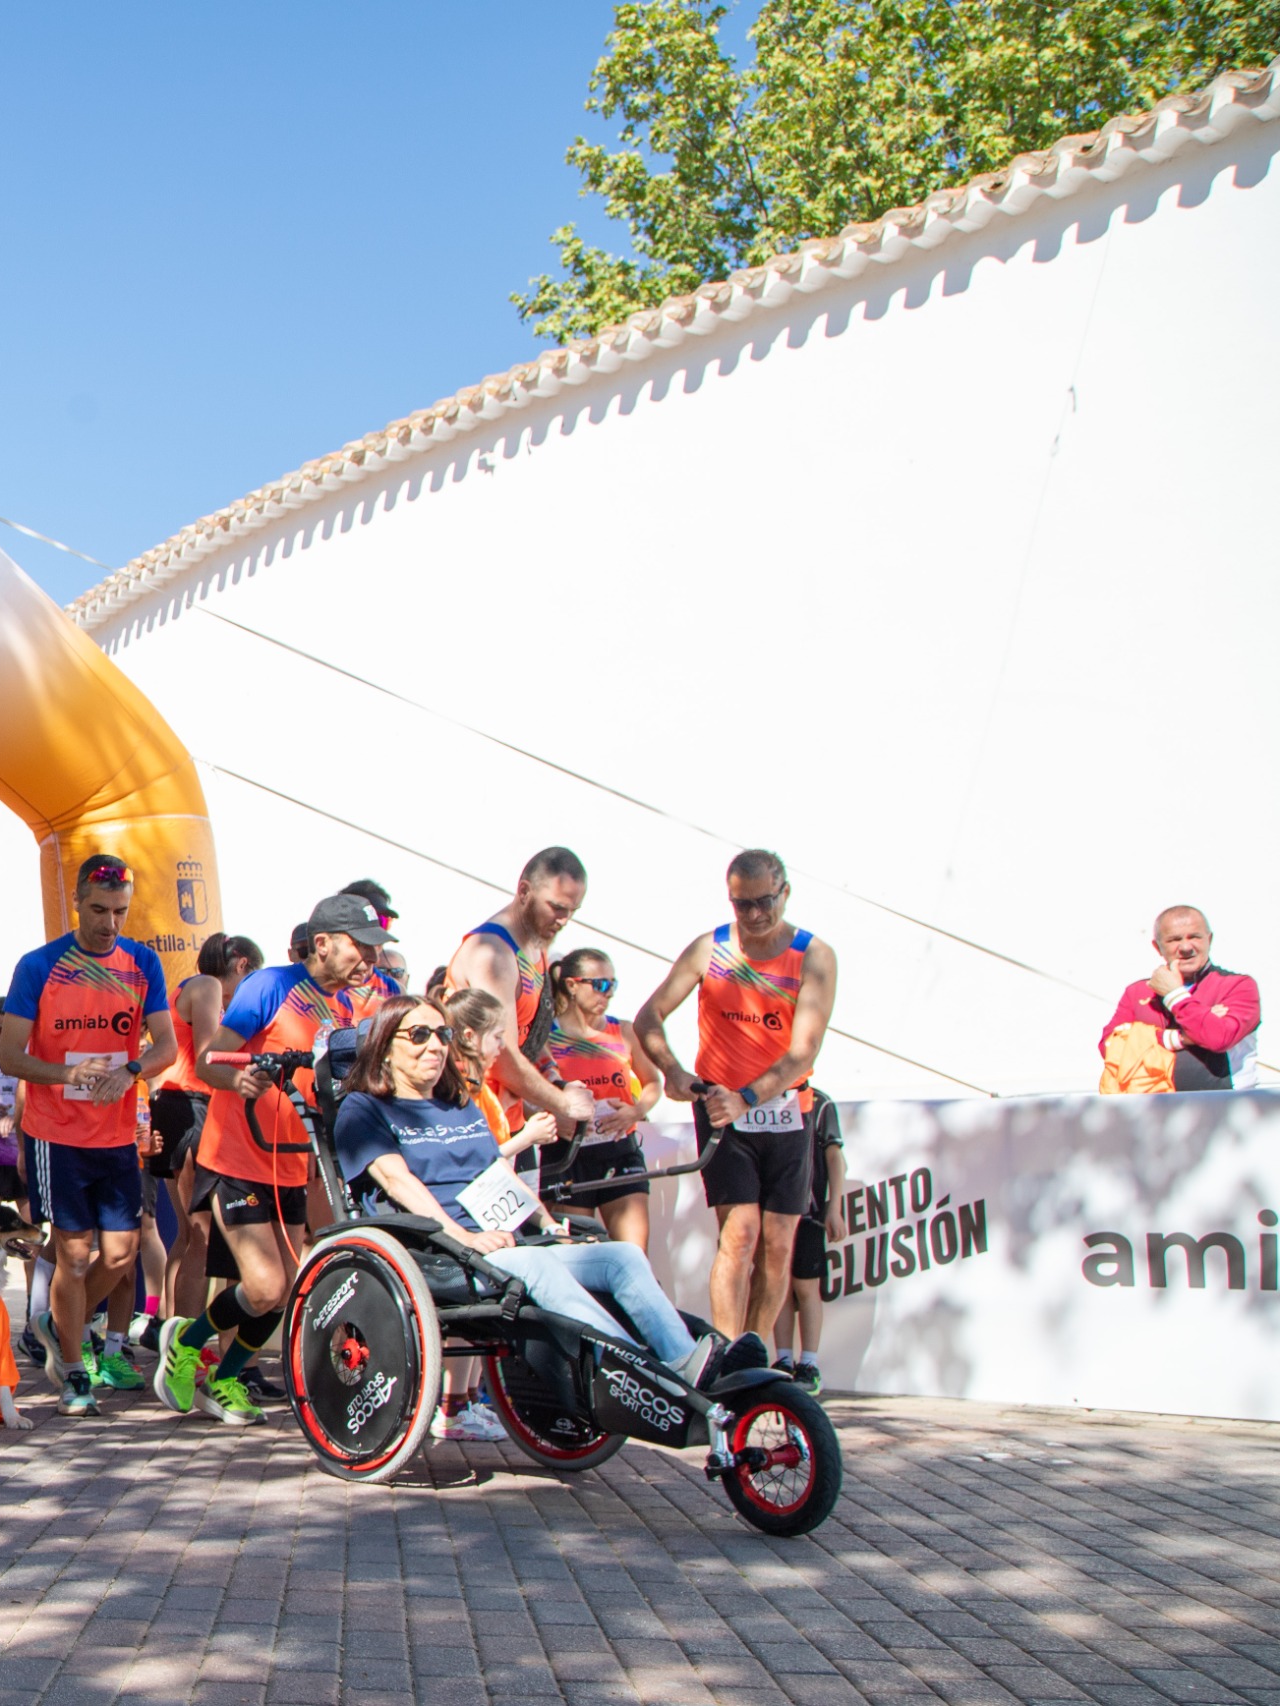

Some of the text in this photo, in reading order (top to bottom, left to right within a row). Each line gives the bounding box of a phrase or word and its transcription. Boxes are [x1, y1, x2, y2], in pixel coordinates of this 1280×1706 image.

[54, 1015, 108, 1030] amiab
[582, 1075, 610, 1086] miab
[743, 1109, 793, 1125] 1018
[482, 1190, 526, 1231] 5022
[1081, 1209, 1279, 1291] ami
[347, 1376, 398, 1434] ARCOS
[361, 1372, 385, 1400] SPORT
[601, 1367, 685, 1425] ARCOS
[609, 1384, 671, 1432] SPORT CLUB
